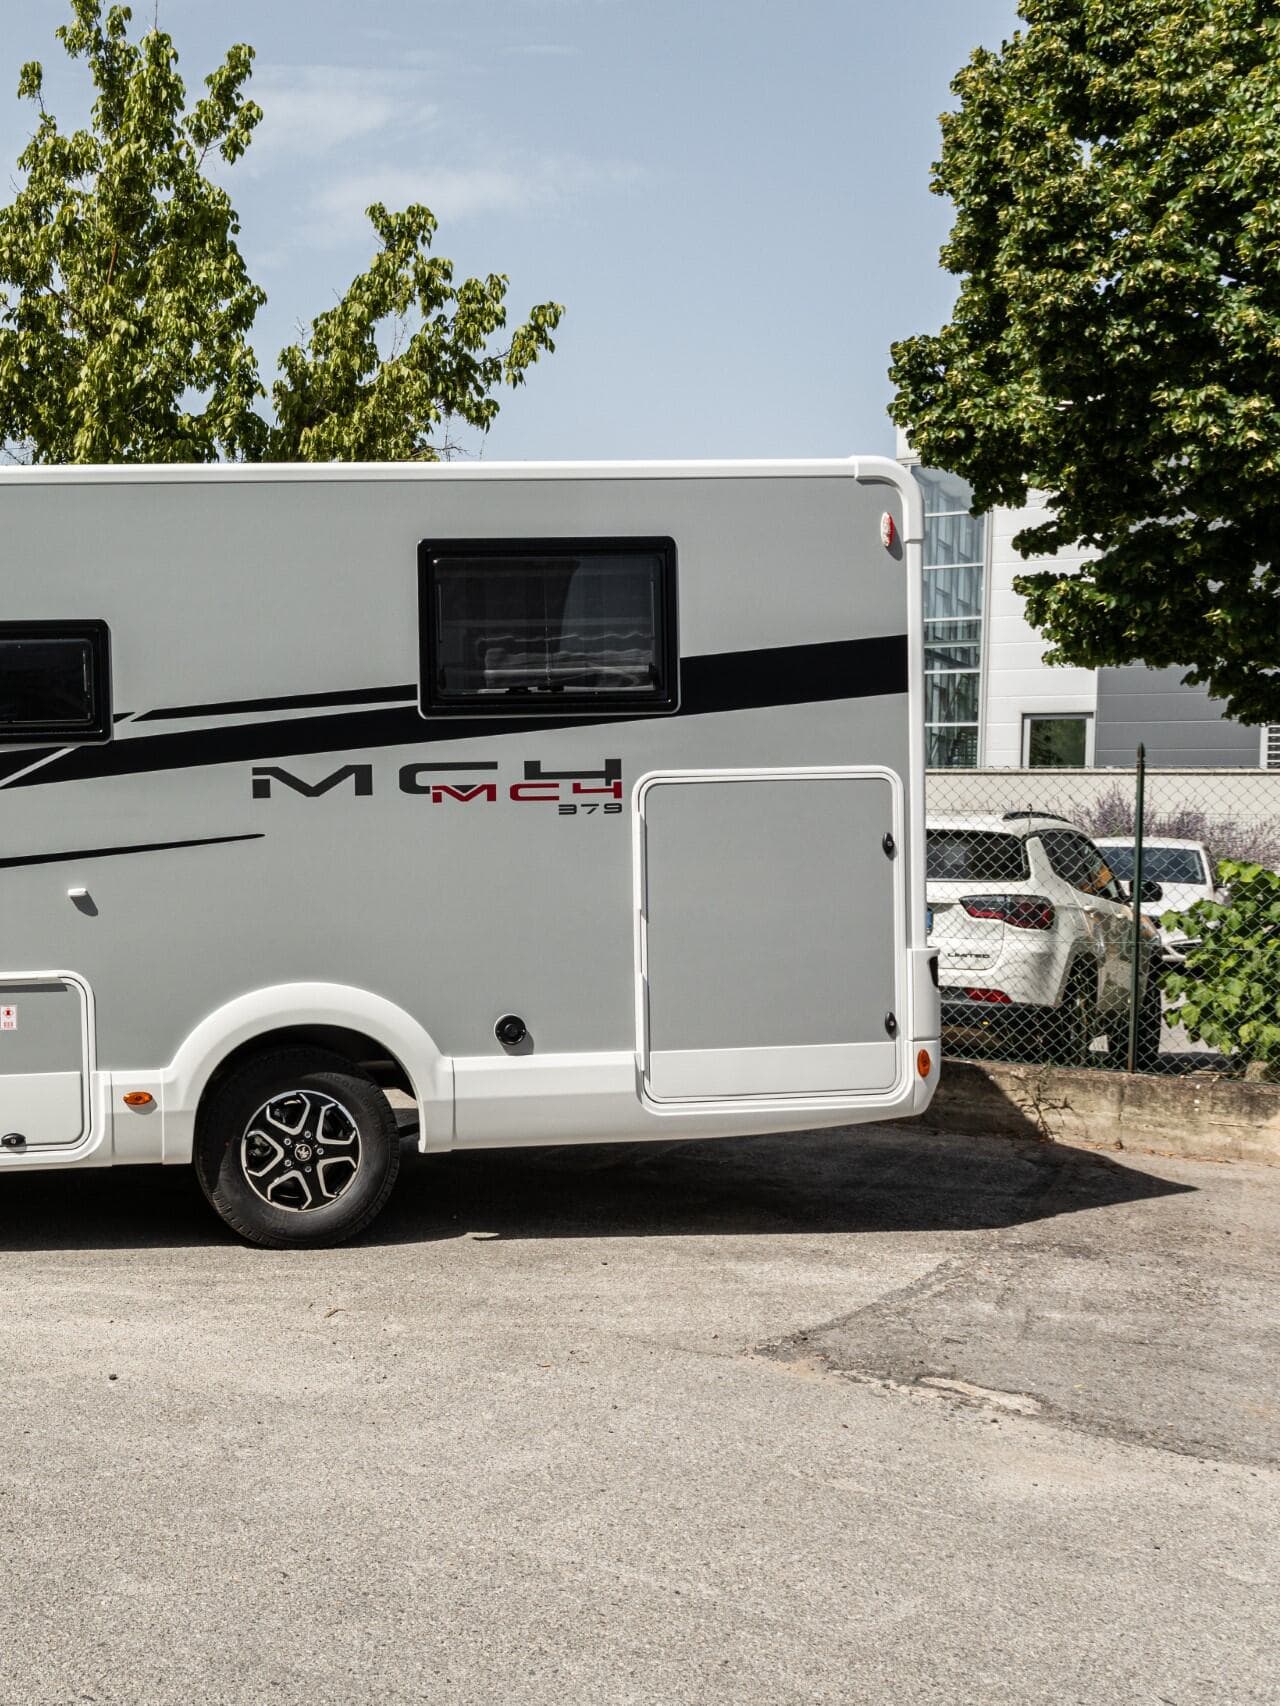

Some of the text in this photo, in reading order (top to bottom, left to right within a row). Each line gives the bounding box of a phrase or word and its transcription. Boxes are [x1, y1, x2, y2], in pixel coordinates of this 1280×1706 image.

[252, 758, 622, 799] MC4
[431, 781, 623, 804] MC4
[558, 803, 623, 816] 379
